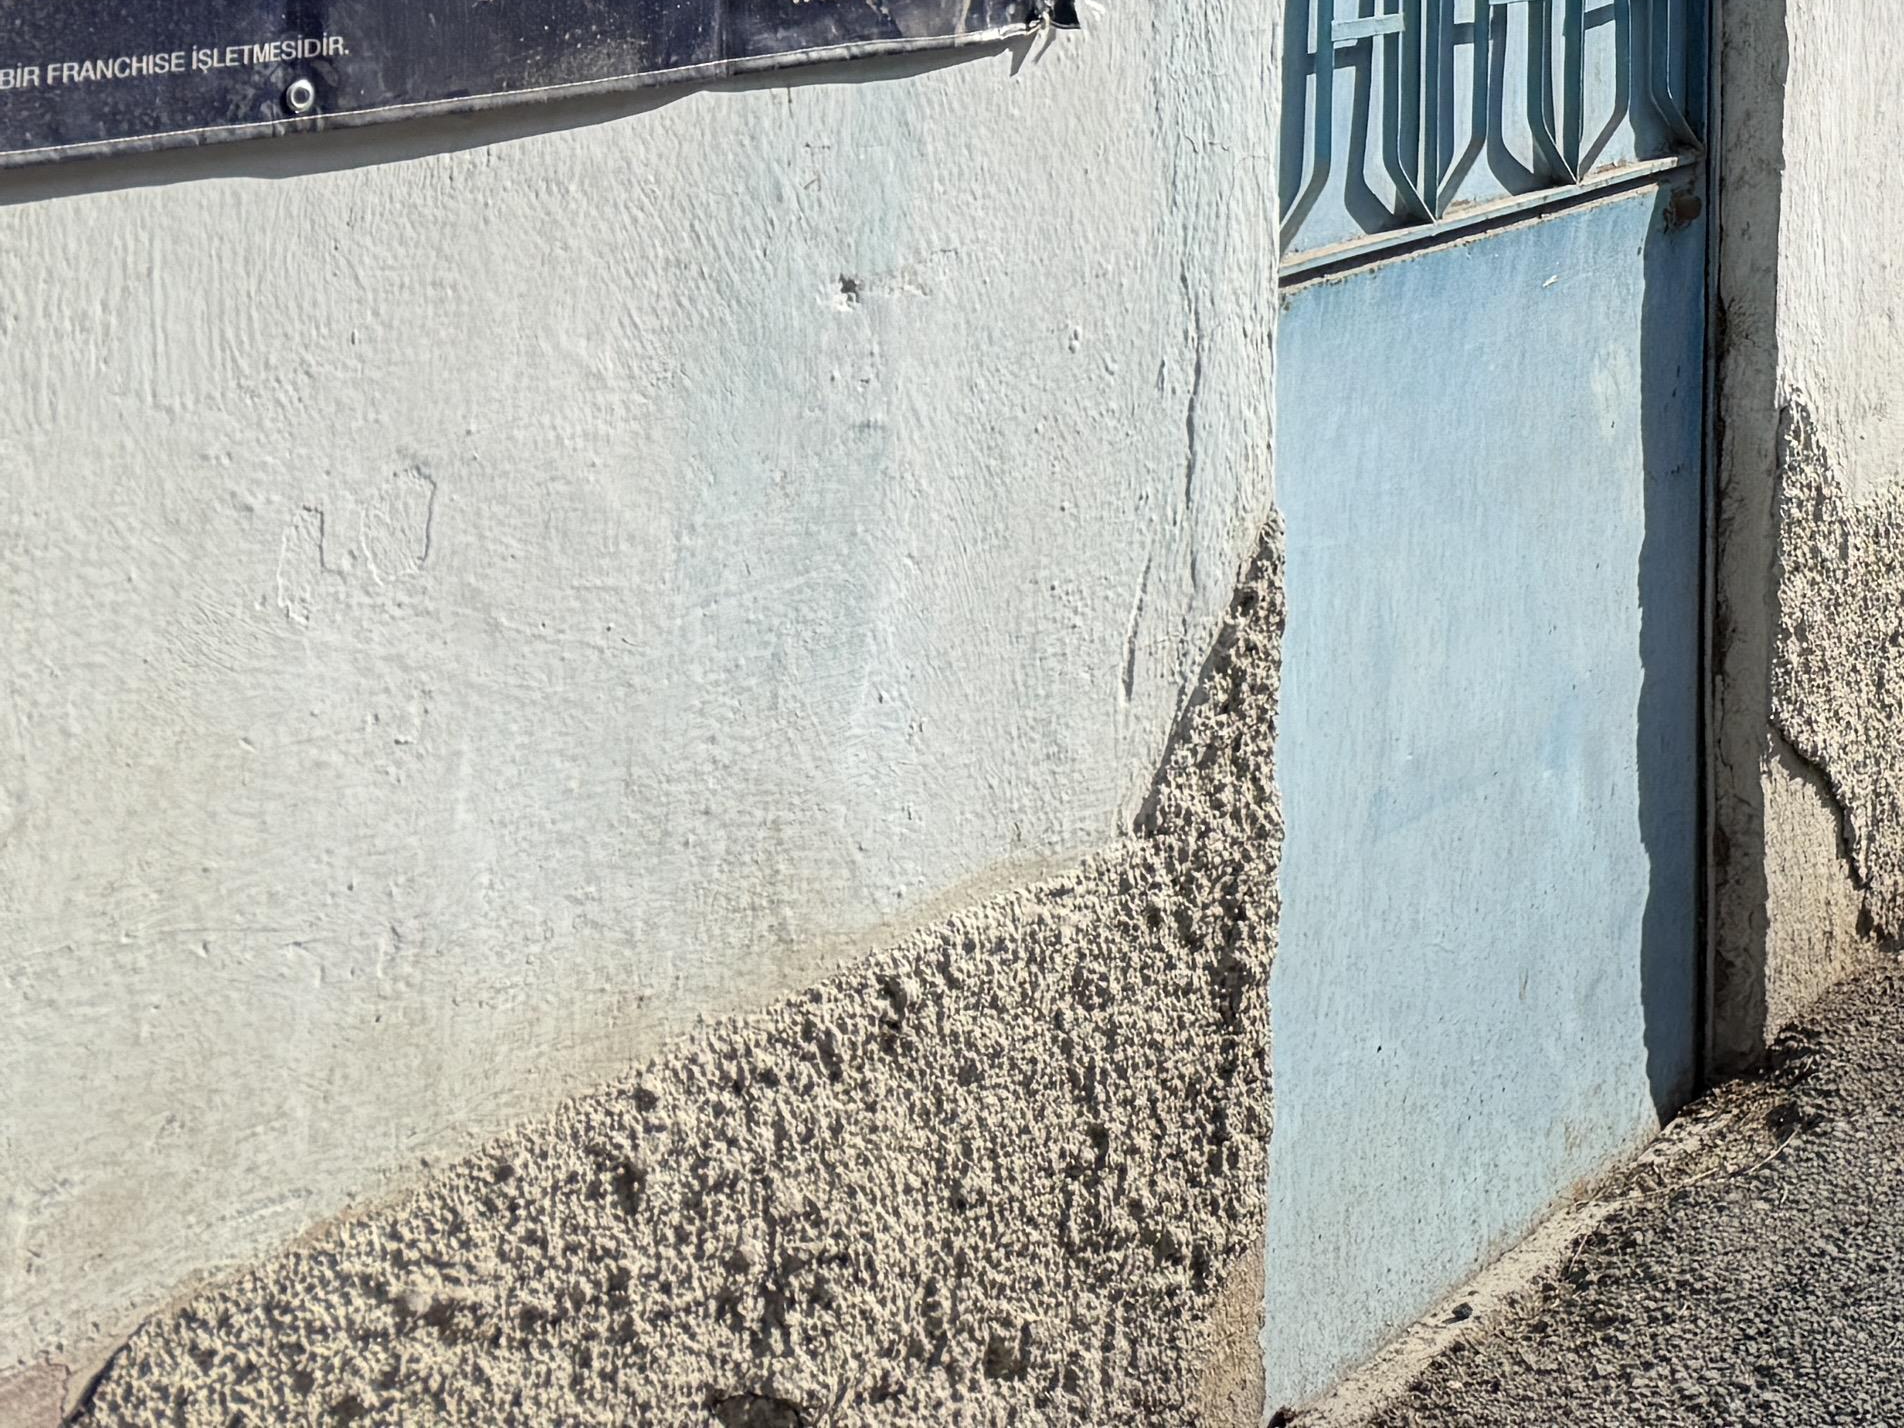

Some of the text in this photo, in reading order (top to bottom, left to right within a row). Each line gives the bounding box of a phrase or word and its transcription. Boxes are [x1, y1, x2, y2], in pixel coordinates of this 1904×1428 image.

[0, 31, 350, 90] BİR FRANCHISE İŞLETMESİDİR.
